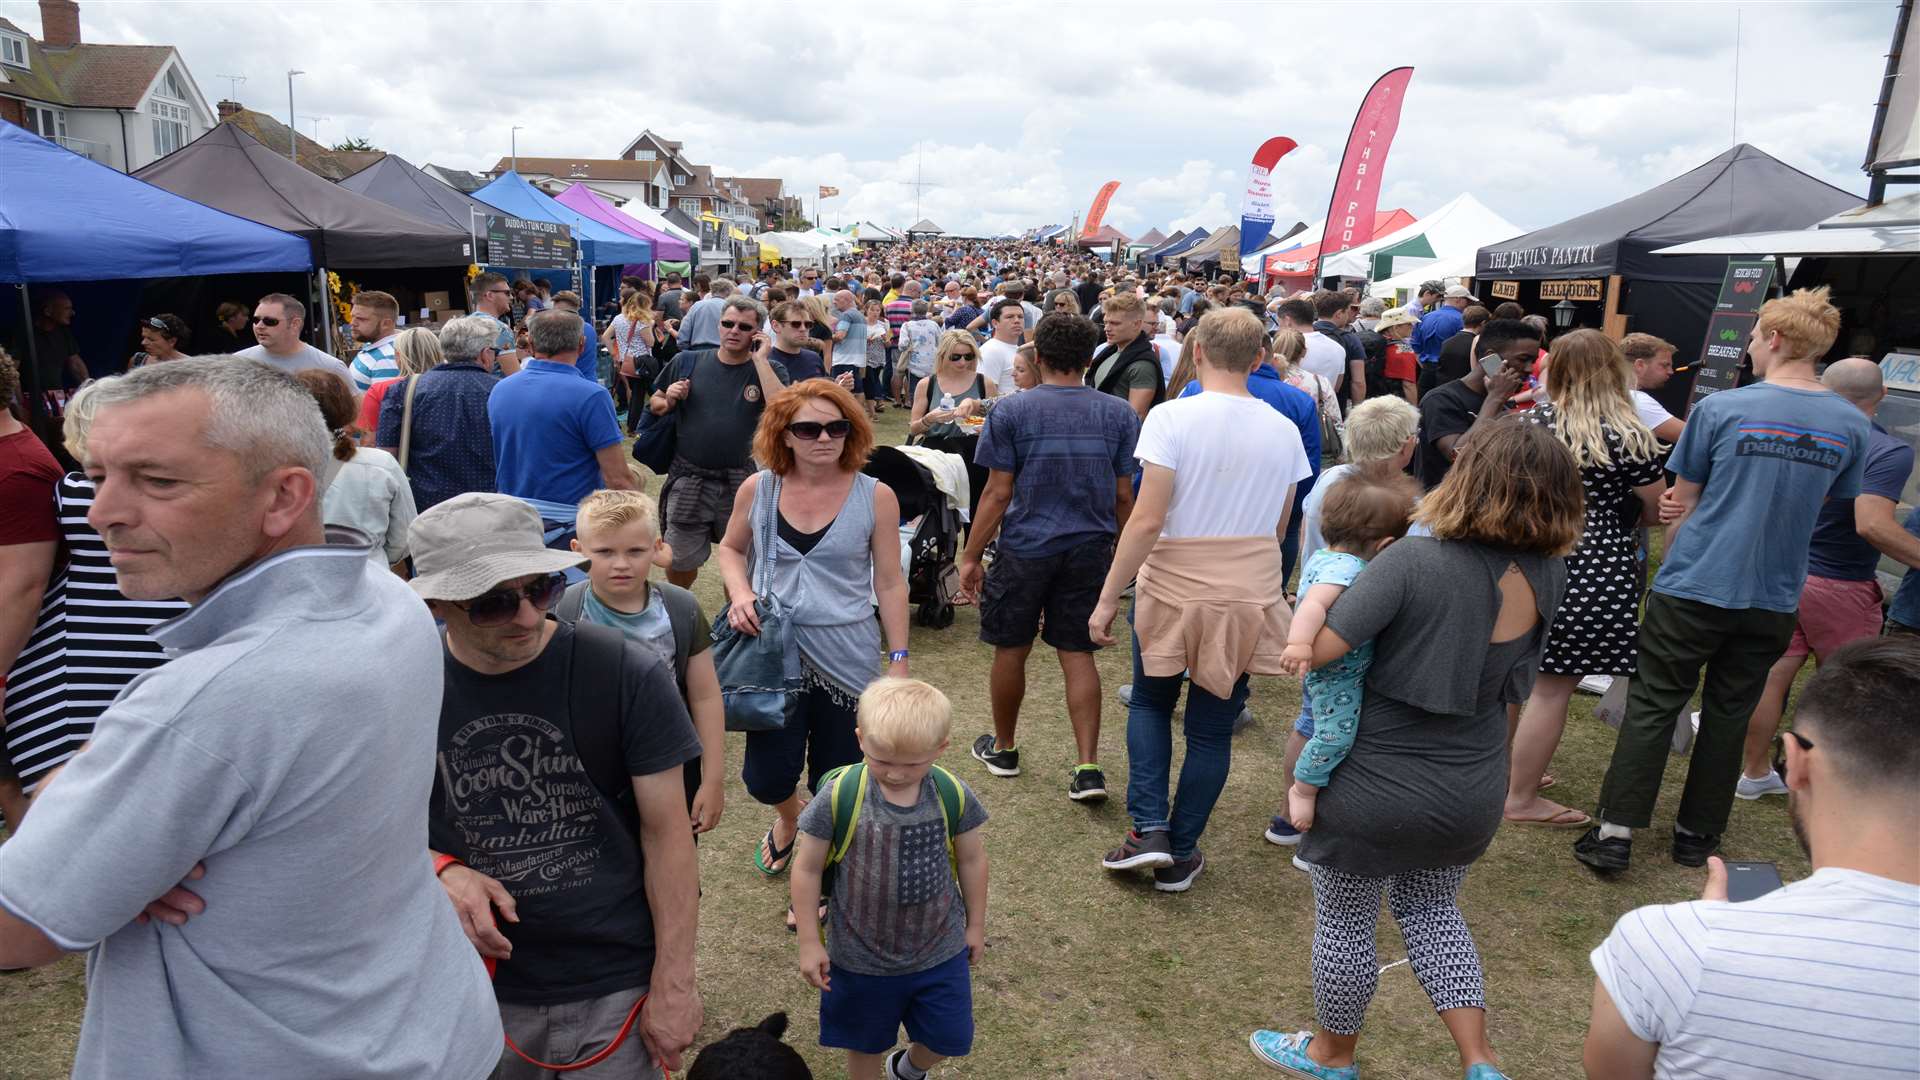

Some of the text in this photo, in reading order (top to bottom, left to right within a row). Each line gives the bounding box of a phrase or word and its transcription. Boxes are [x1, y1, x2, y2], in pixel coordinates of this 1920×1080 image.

[1489, 243, 1600, 274] THE DEVIL'S PANTRY
[1493, 283, 1516, 297] LAMB
[1708, 344, 1742, 358] BREAKFAST
[1743, 440, 1840, 465] patagonia
[479, 714, 519, 728] YORK'S
